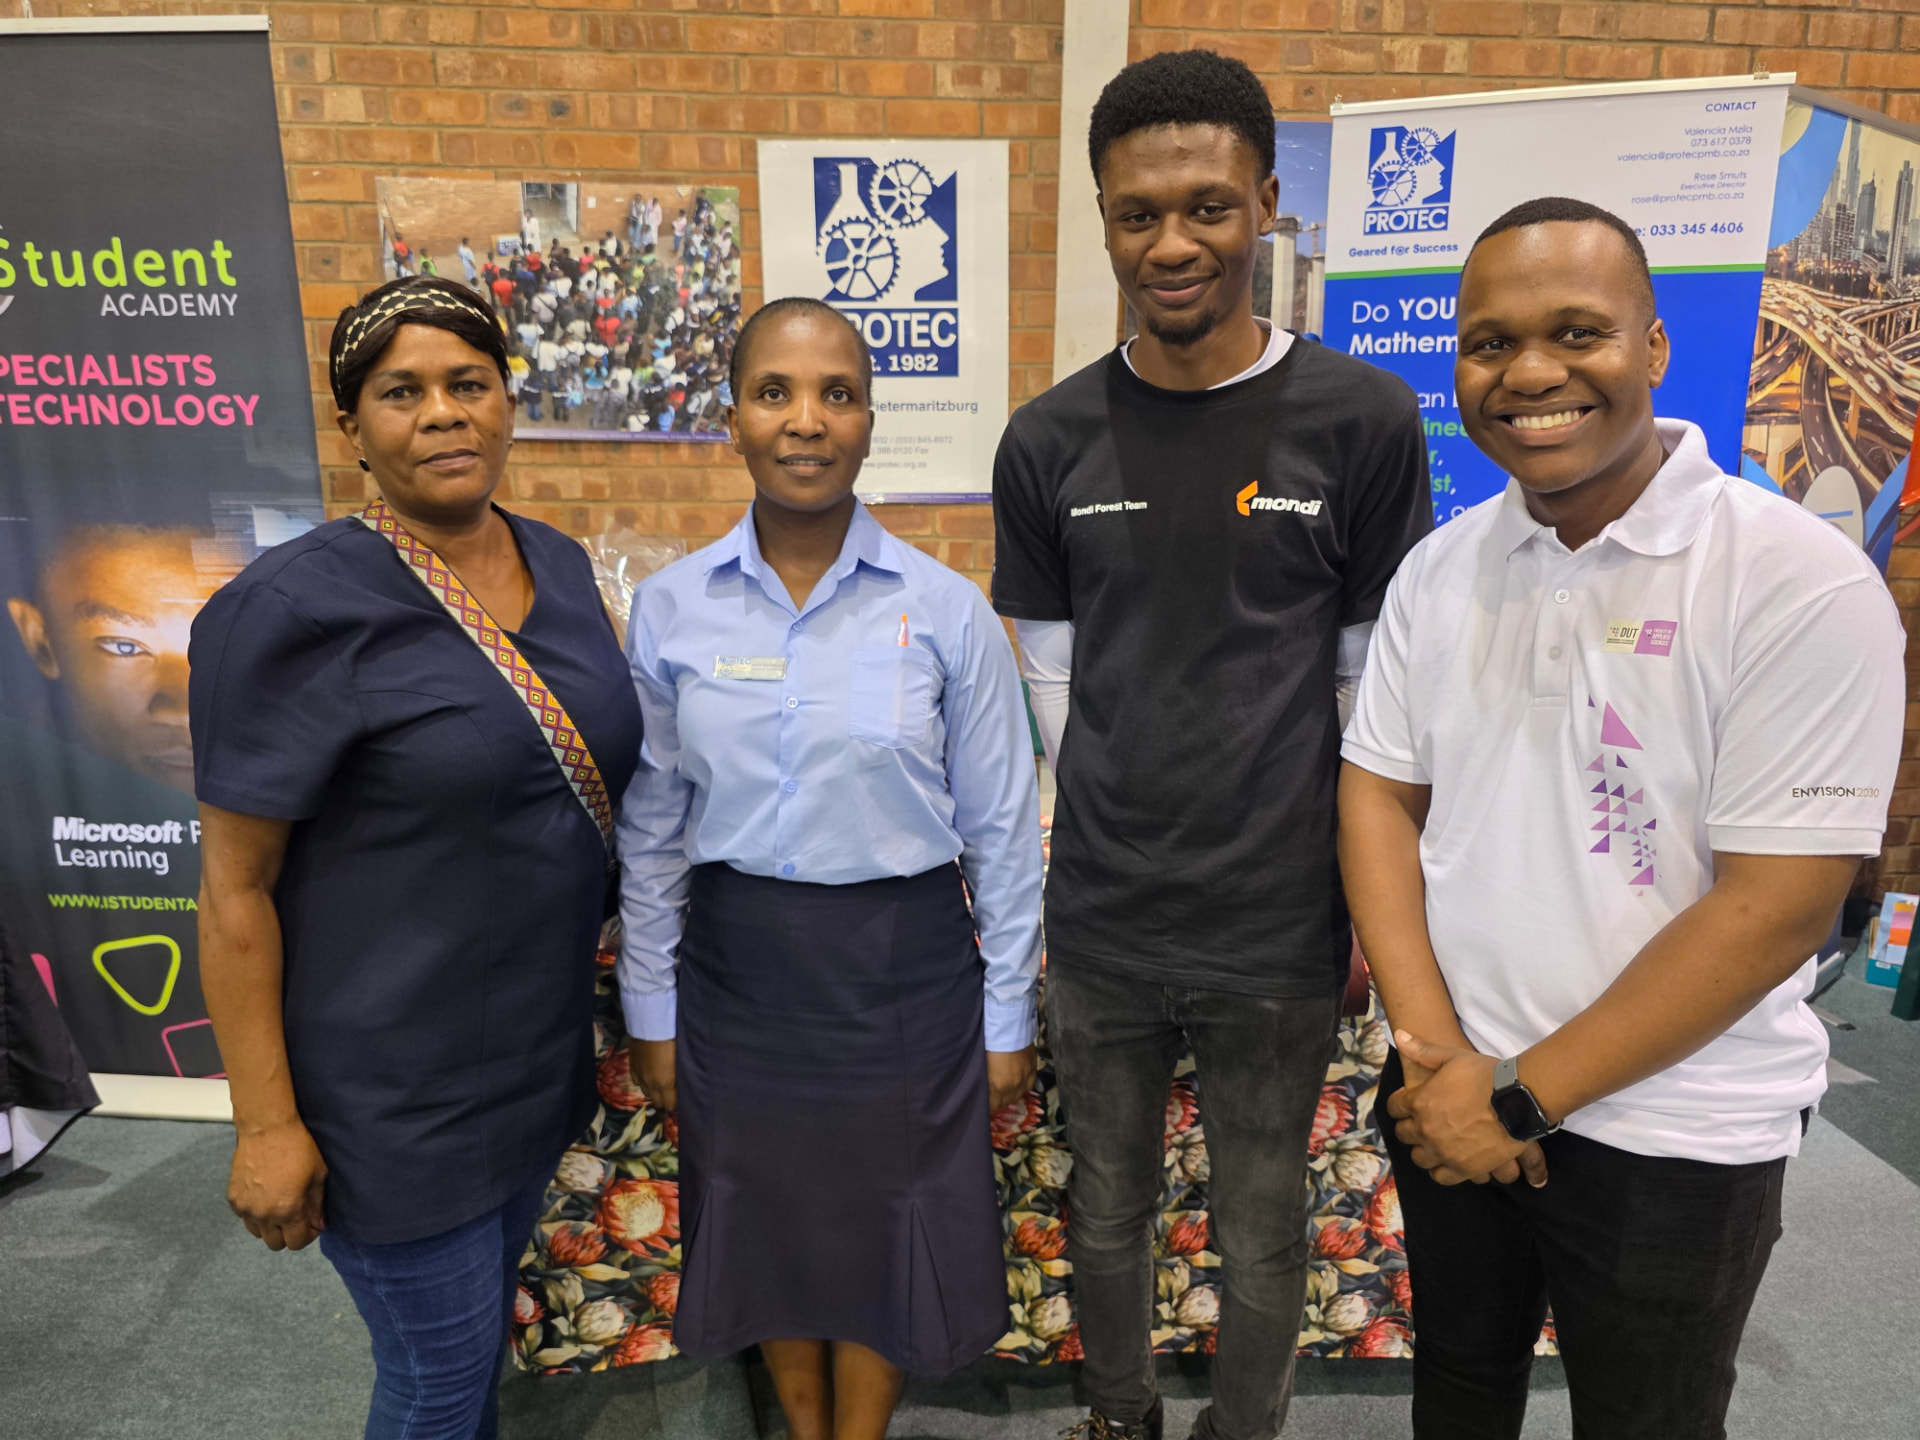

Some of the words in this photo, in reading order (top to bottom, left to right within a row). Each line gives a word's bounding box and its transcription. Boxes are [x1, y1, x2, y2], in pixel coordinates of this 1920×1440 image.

[1705, 101, 1757, 112] CONTACT
[1685, 127, 1726, 136] Valencia
[1729, 125, 1753, 134] Mzila
[1691, 139, 1708, 147] 073
[1711, 138, 1726, 146] 617
[1729, 136, 1752, 145] 0378
[1617, 149, 1750, 162] valencia@protecpmb.co.za
[1694, 172, 1717, 181] Rose
[1719, 171, 1748, 180] Smuts
[1631, 192, 1745, 205] rose@protecpmb.co.za
[1365, 208, 1448, 233] PROTEC
[1650, 225, 1676, 236] 033
[1680, 223, 1706, 234] 345
[1710, 222, 1744, 233] 4606
[1349, 246, 1387, 257] Geared
[1413, 244, 1458, 254] Success
[100, 293, 238, 317] ACADEMY
[1352, 301, 1390, 323] Do
[1399, 297, 1456, 321] YOU
[888, 354, 939, 372] 1982
[0, 394, 260, 426] ECHNOLOGY
[874, 400, 978, 414] ietermaritzburg
[1095, 502, 1123, 513] Forest
[1124, 501, 1148, 510] Team
[1250, 497, 1322, 516] mondi
[1620, 627, 1639, 639] DUT
[53, 816, 182, 843] Microsoft
[54, 843, 169, 875] Learning
